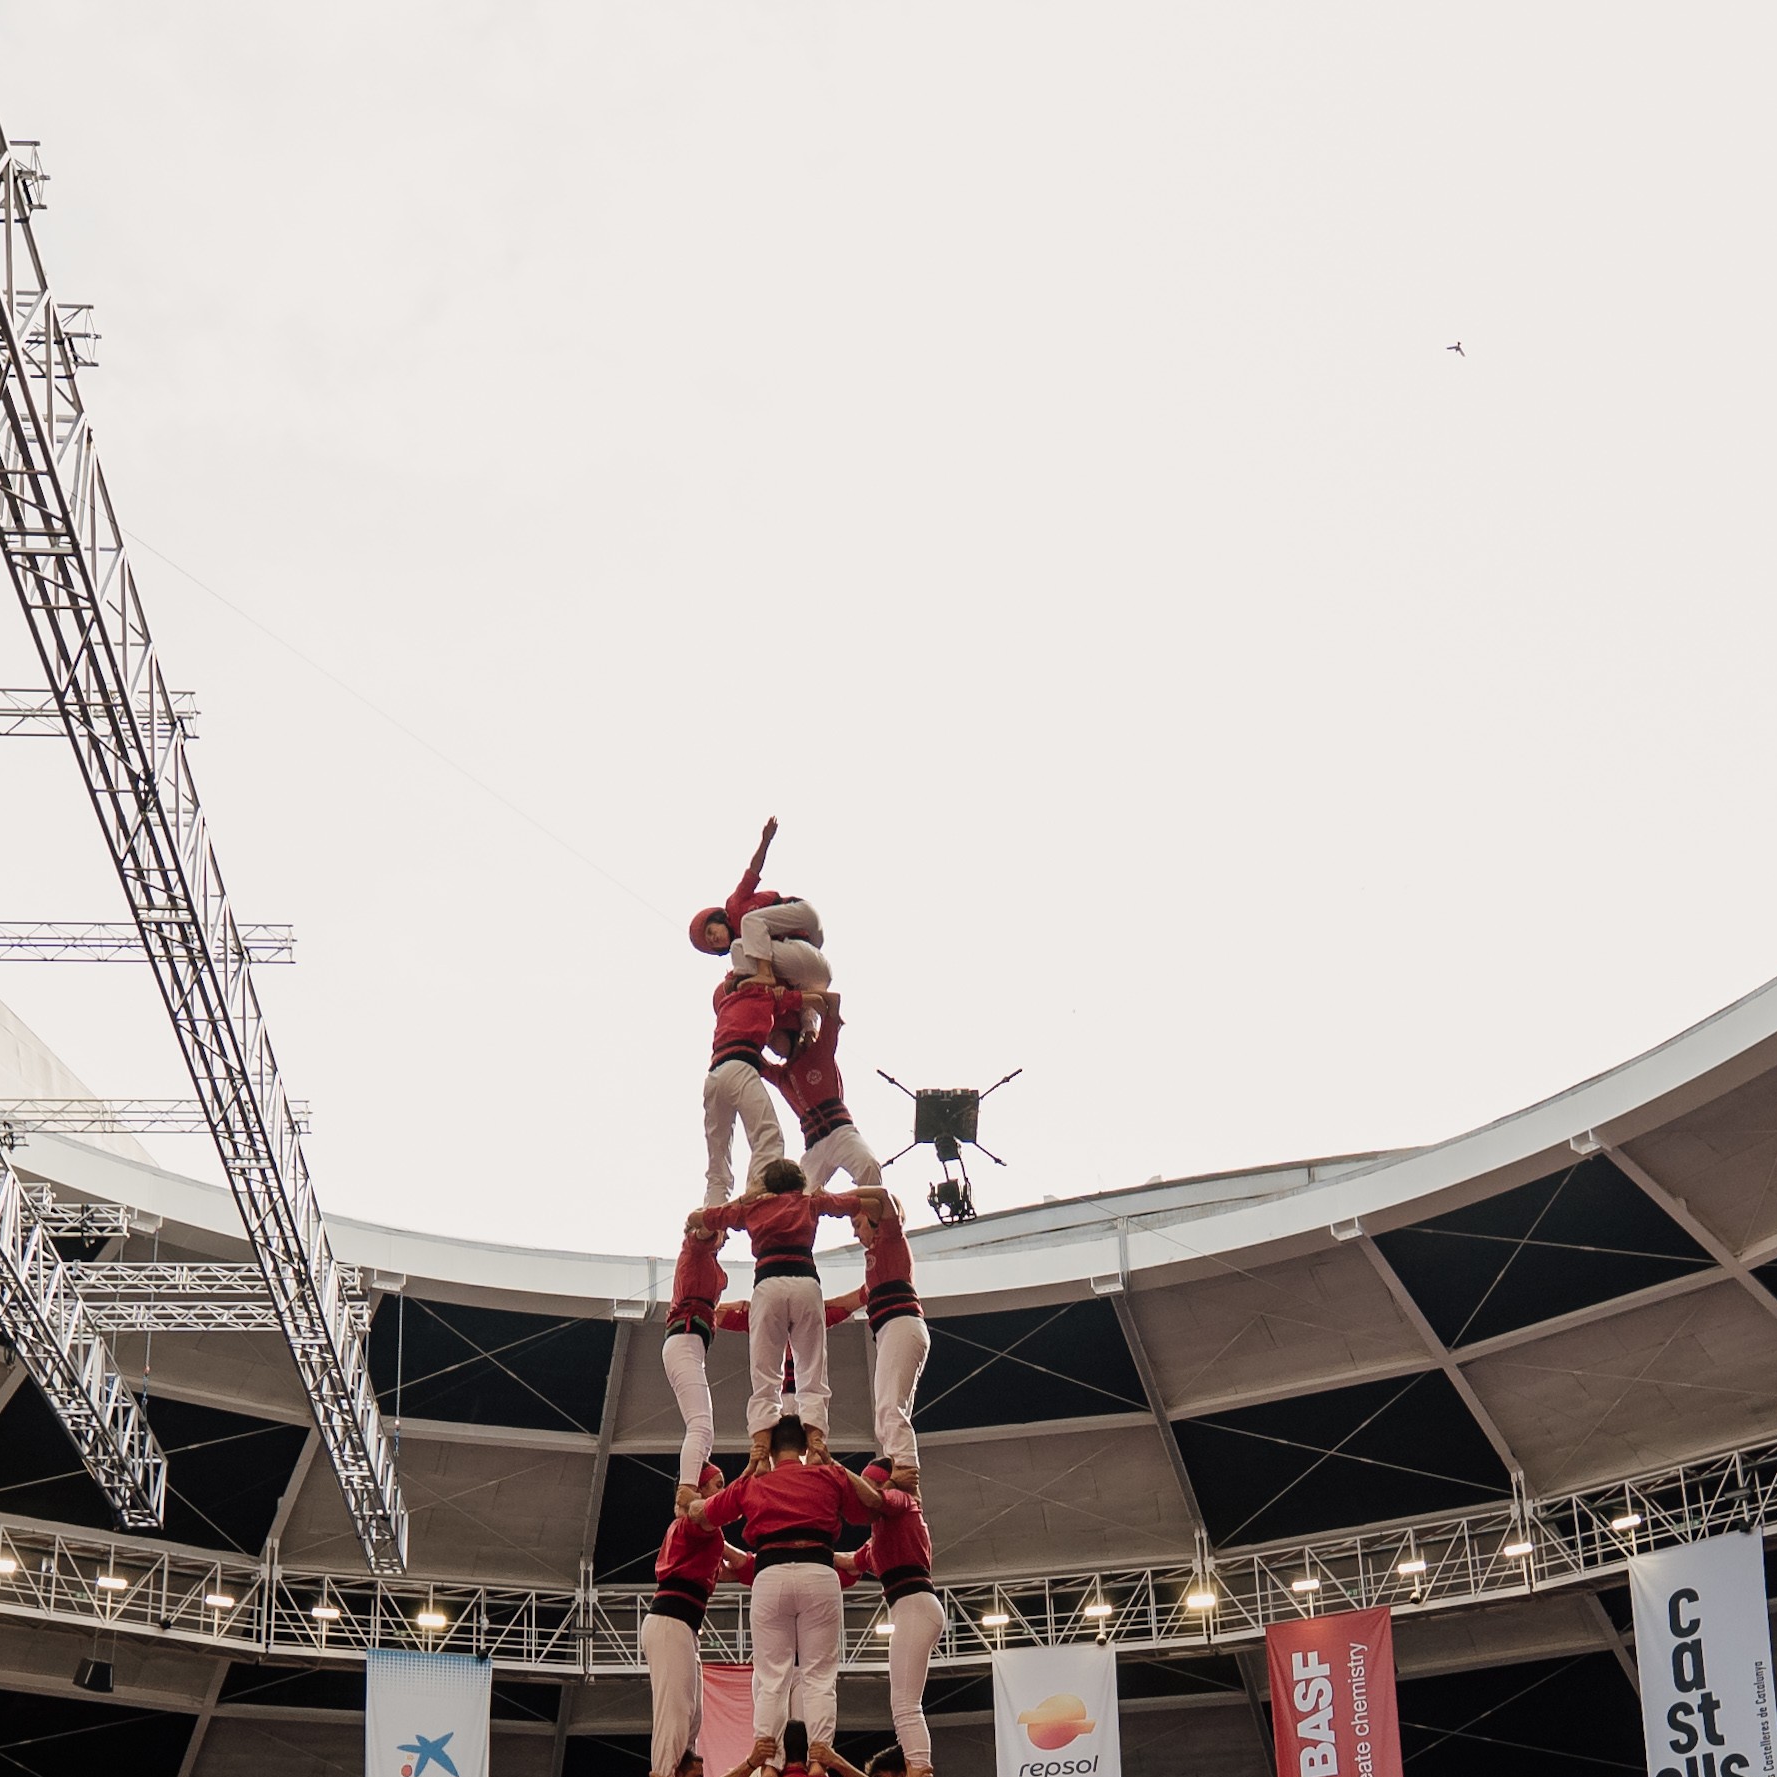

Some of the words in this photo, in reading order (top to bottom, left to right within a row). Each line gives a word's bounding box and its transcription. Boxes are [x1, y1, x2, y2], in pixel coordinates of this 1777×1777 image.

[1347, 1642, 1370, 1738] chemistry
[1755, 1661, 1767, 1705] Catalunya
[1757, 1706, 1768, 1718] de
[1759, 1719, 1775, 1773] Castelleres
